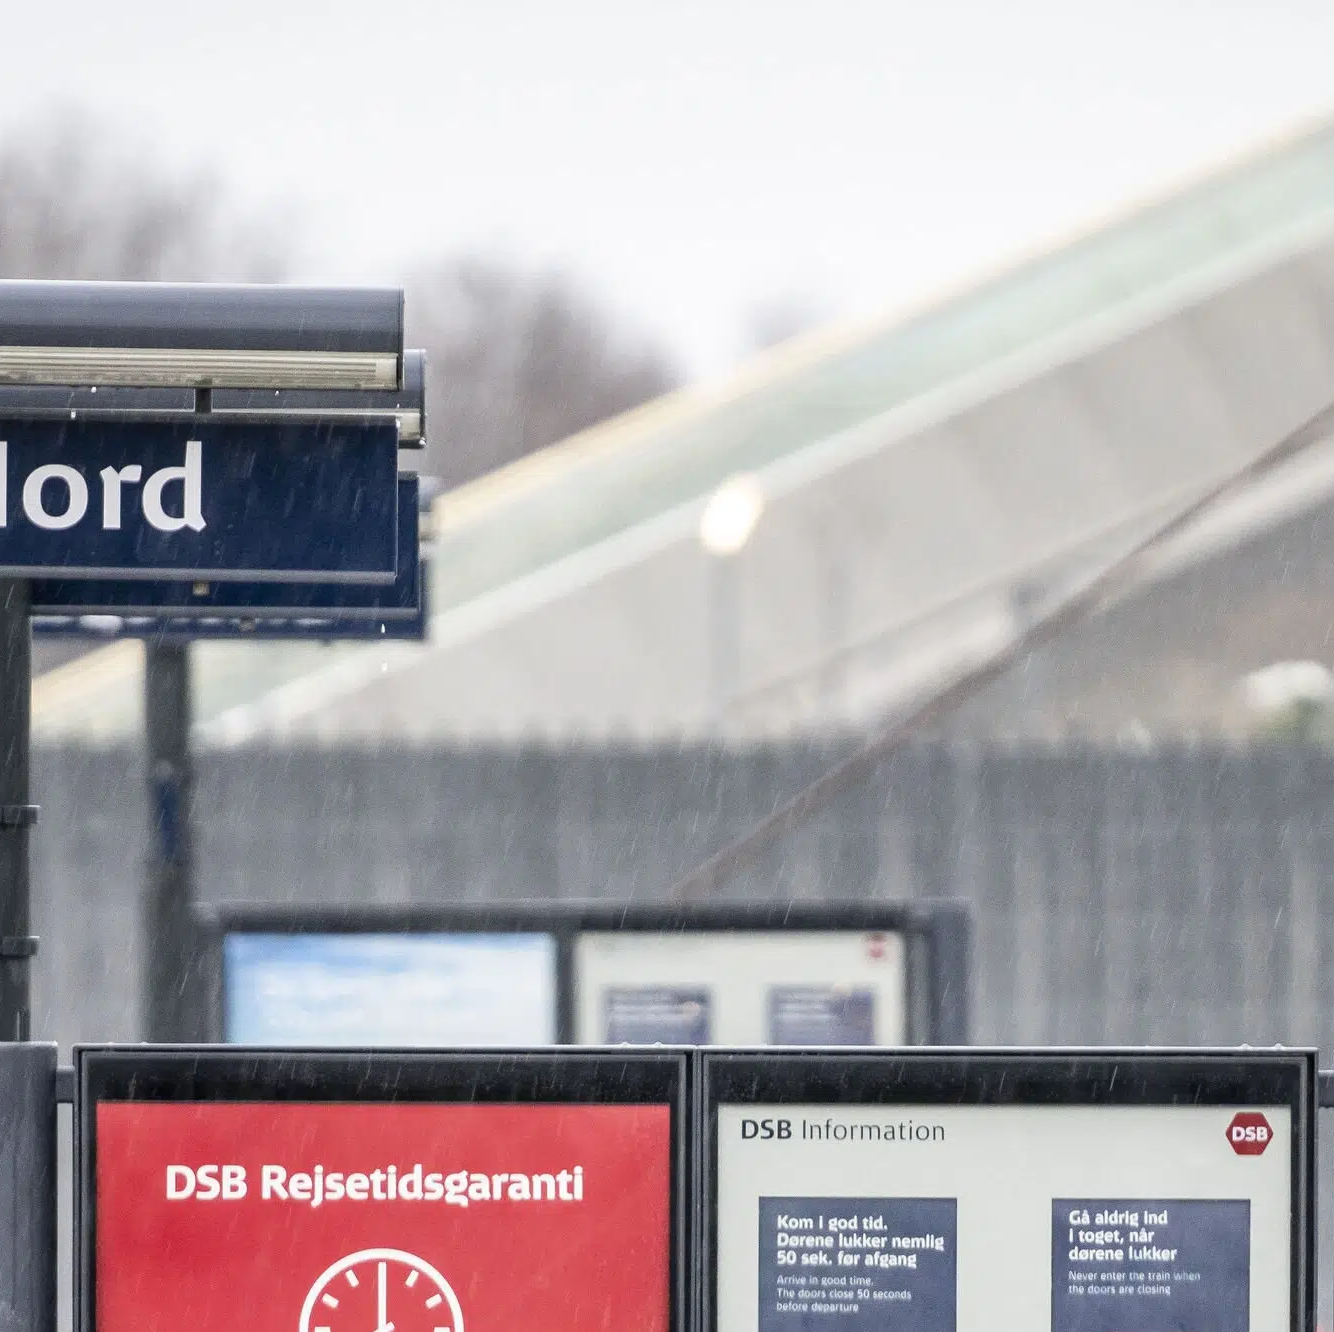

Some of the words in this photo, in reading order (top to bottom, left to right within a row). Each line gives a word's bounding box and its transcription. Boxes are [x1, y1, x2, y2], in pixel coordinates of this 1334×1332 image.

[741, 1119, 792, 1140] DSB
[802, 1118, 945, 1141] Information
[1231, 1126, 1268, 1142] DSB
[166, 1164, 247, 1201] DSB
[262, 1163, 583, 1209] Rejsetidsgaranti
[777, 1214, 814, 1230] Kom
[828, 1215, 858, 1233] god
[862, 1215, 888, 1231] tid.
[1069, 1209, 1090, 1226] Gå
[1095, 1209, 1139, 1228] aldrig
[1144, 1209, 1168, 1225] ind
[776, 1232, 835, 1252] Dørene
[838, 1232, 888, 1249] lukker
[891, 1233, 945, 1252] nemlig
[1078, 1229, 1125, 1246] toget,
[1129, 1227, 1155, 1243] når
[777, 1249, 797, 1266] 50
[801, 1250, 833, 1266] sek.
[837, 1250, 861, 1267] før
[864, 1250, 917, 1269] afgang
[1068, 1245, 1124, 1261] dørene
[1128, 1245, 1178, 1262] lukker
